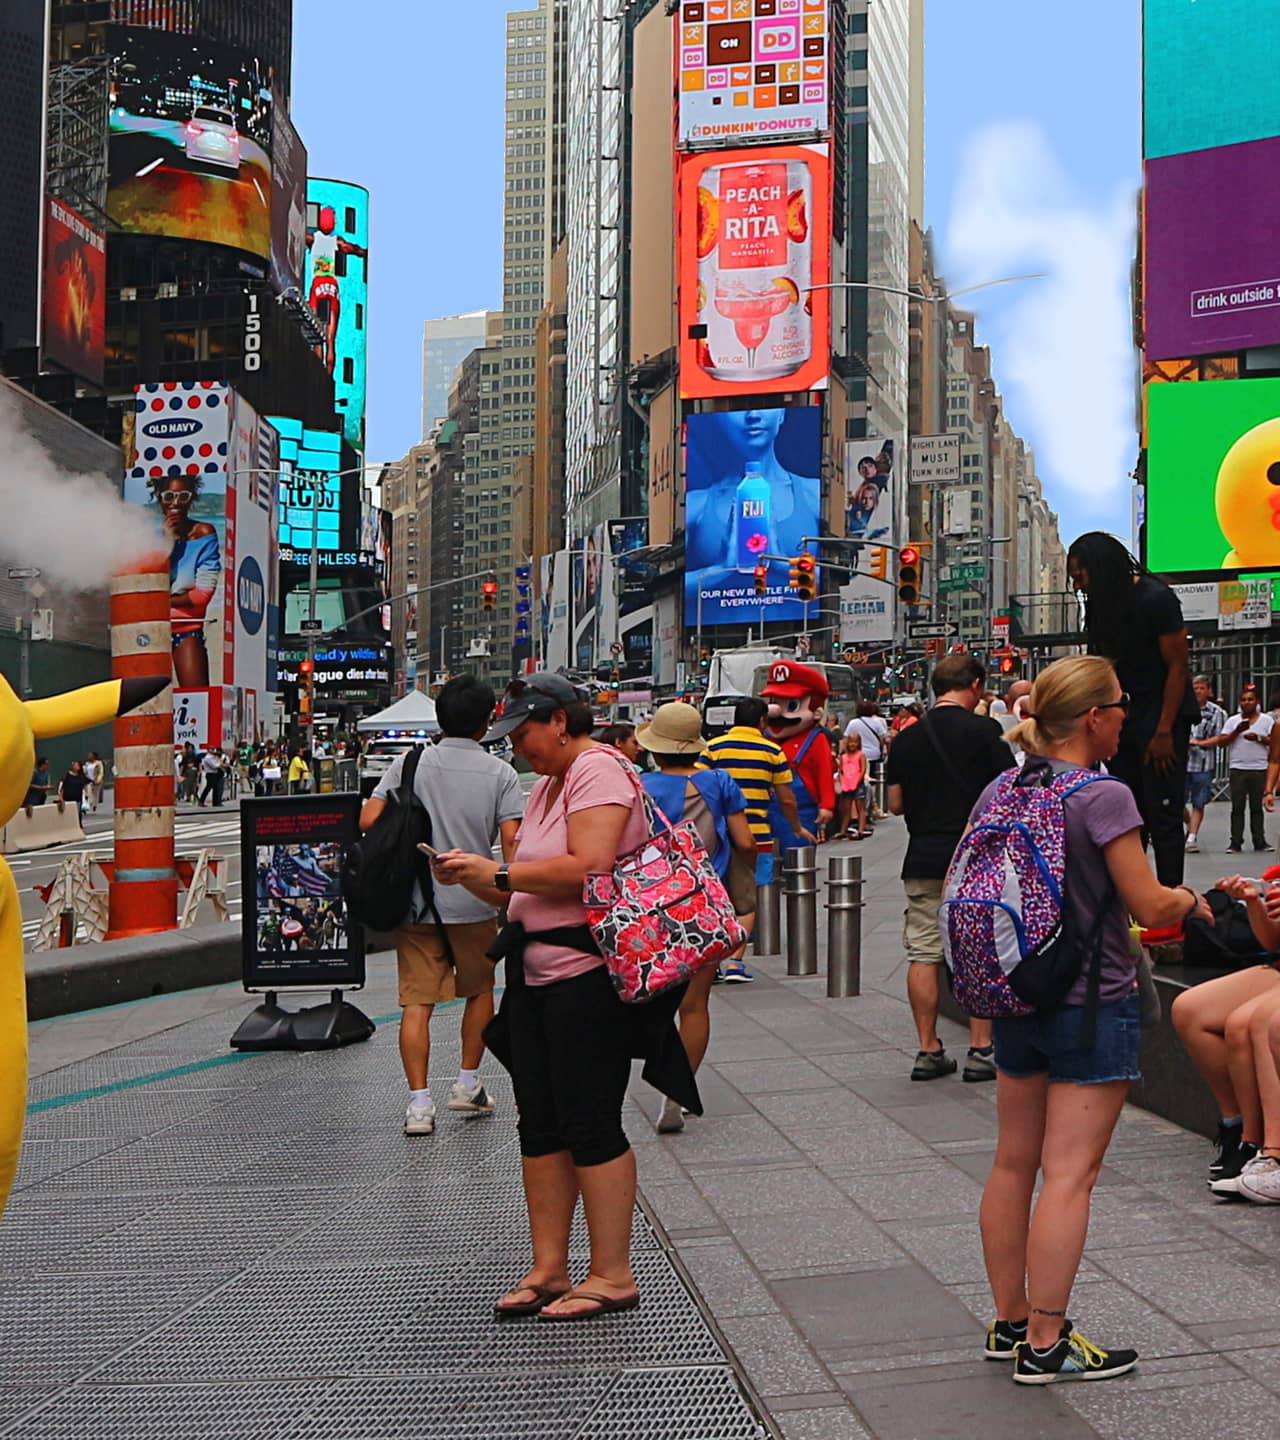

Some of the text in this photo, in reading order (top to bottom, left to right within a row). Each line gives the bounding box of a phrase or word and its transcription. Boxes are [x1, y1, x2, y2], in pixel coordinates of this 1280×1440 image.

[763, 31, 793, 48] DD
[725, 185, 781, 203] PEACH
[725, 215, 780, 240] RITA
[1196, 289, 1227, 312] drink
[1230, 284, 1275, 307] outside
[244, 288, 262, 373] 1500
[148, 421, 196, 434] OLD NAVY
[912, 439, 935, 450] RIGHT
[921, 453, 949, 463] MUST
[912, 465, 960, 478] TURN RIGHT
[742, 500, 765, 518] FIJI
[700, 589, 721, 599] OUR
[722, 588, 746, 598] NEW
[720, 596, 785, 608] EVERYWHERE
